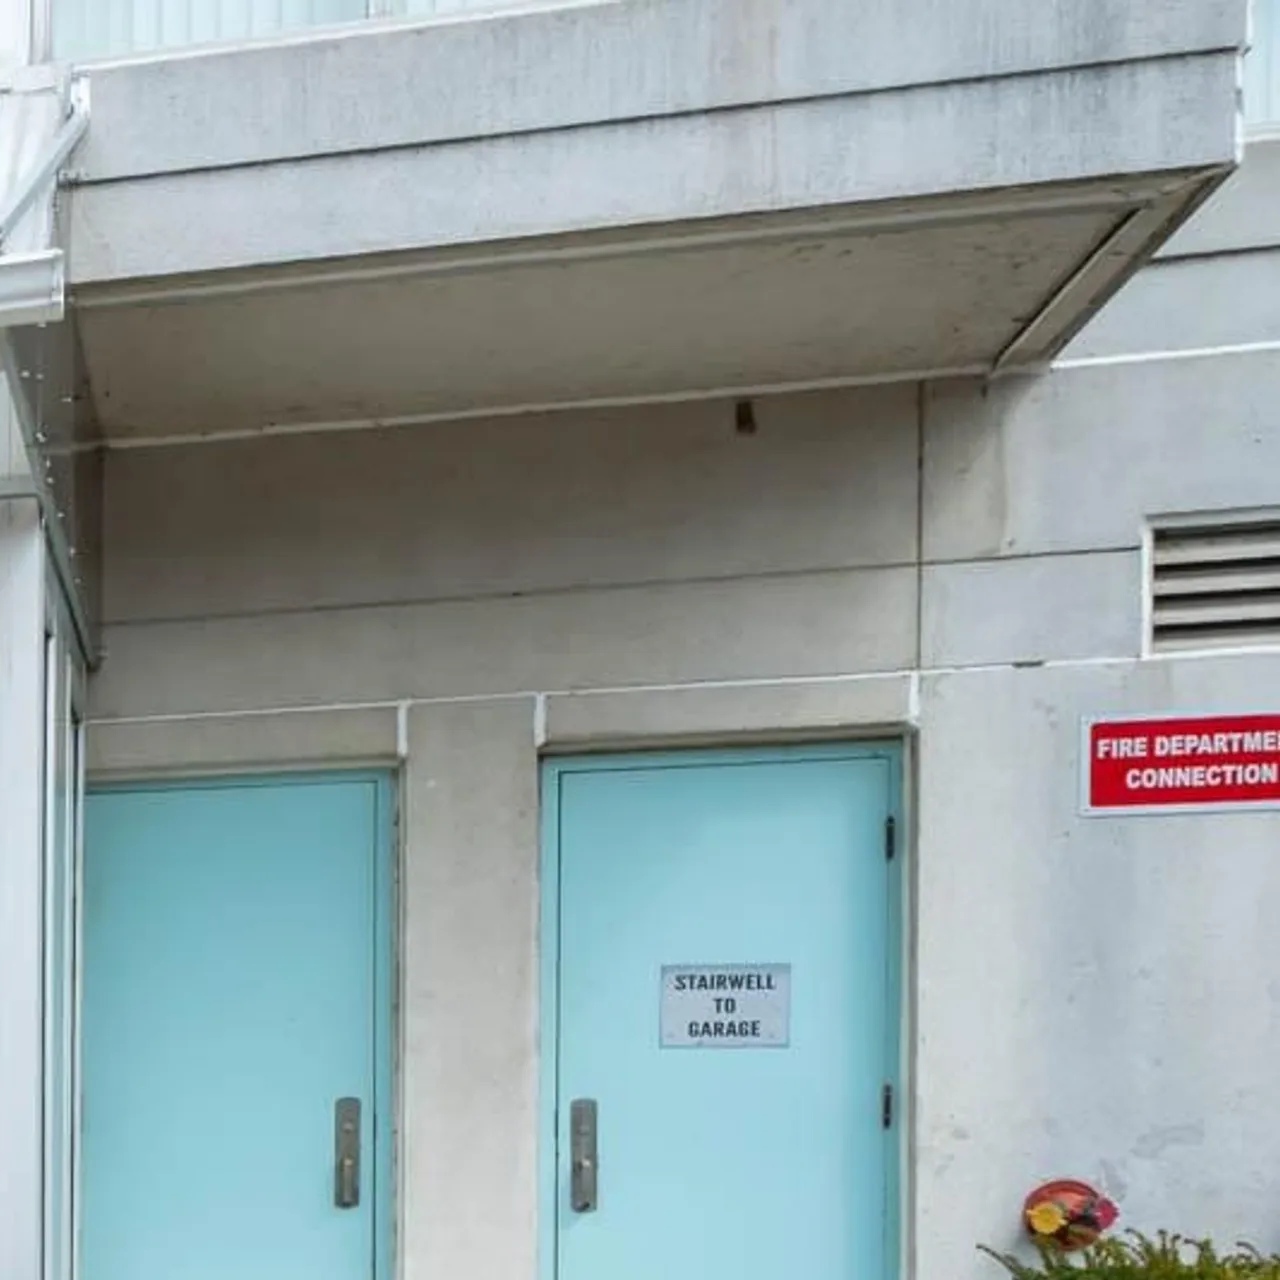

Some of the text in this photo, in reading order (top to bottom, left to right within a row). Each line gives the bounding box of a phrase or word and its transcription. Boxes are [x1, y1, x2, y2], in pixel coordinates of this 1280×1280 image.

[1096, 730, 1280, 759] FIRE DEPARTME
[1126, 762, 1277, 789] CONNECTION
[674, 973, 777, 991] STAIRWELL
[712, 998, 737, 1014] TO
[687, 1020, 761, 1038] GARAGE
